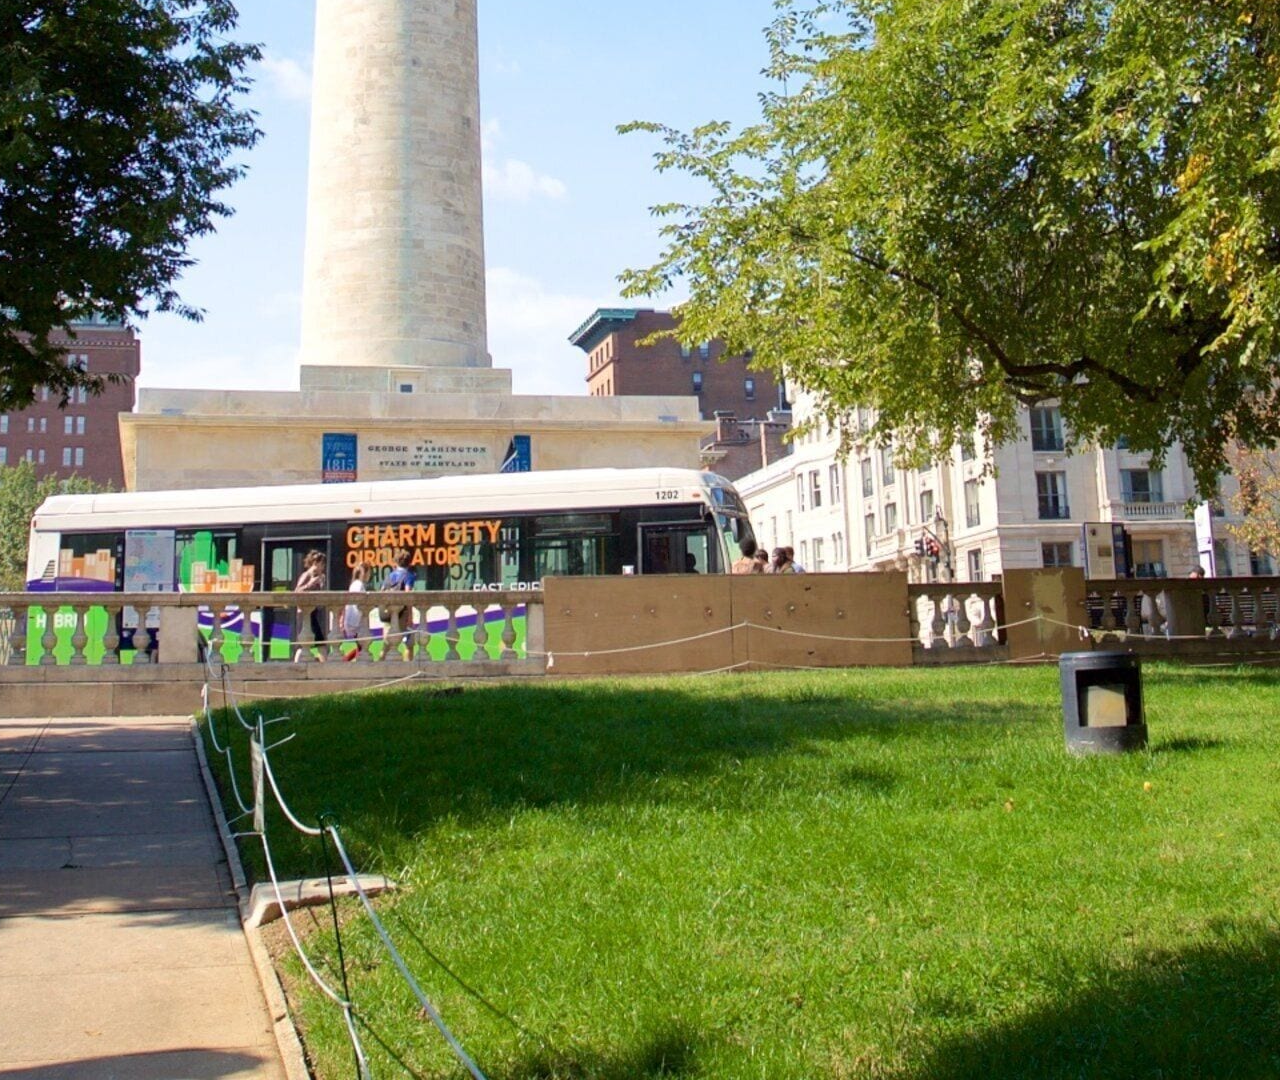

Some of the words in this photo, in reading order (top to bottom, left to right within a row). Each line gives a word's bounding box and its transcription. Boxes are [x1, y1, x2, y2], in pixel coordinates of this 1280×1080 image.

[325, 458, 354, 471] 1815
[656, 490, 678, 500] 1202
[347, 523, 436, 548] CHARM
[444, 520, 501, 545] CITY
[346, 546, 460, 569] CIRCUATOR
